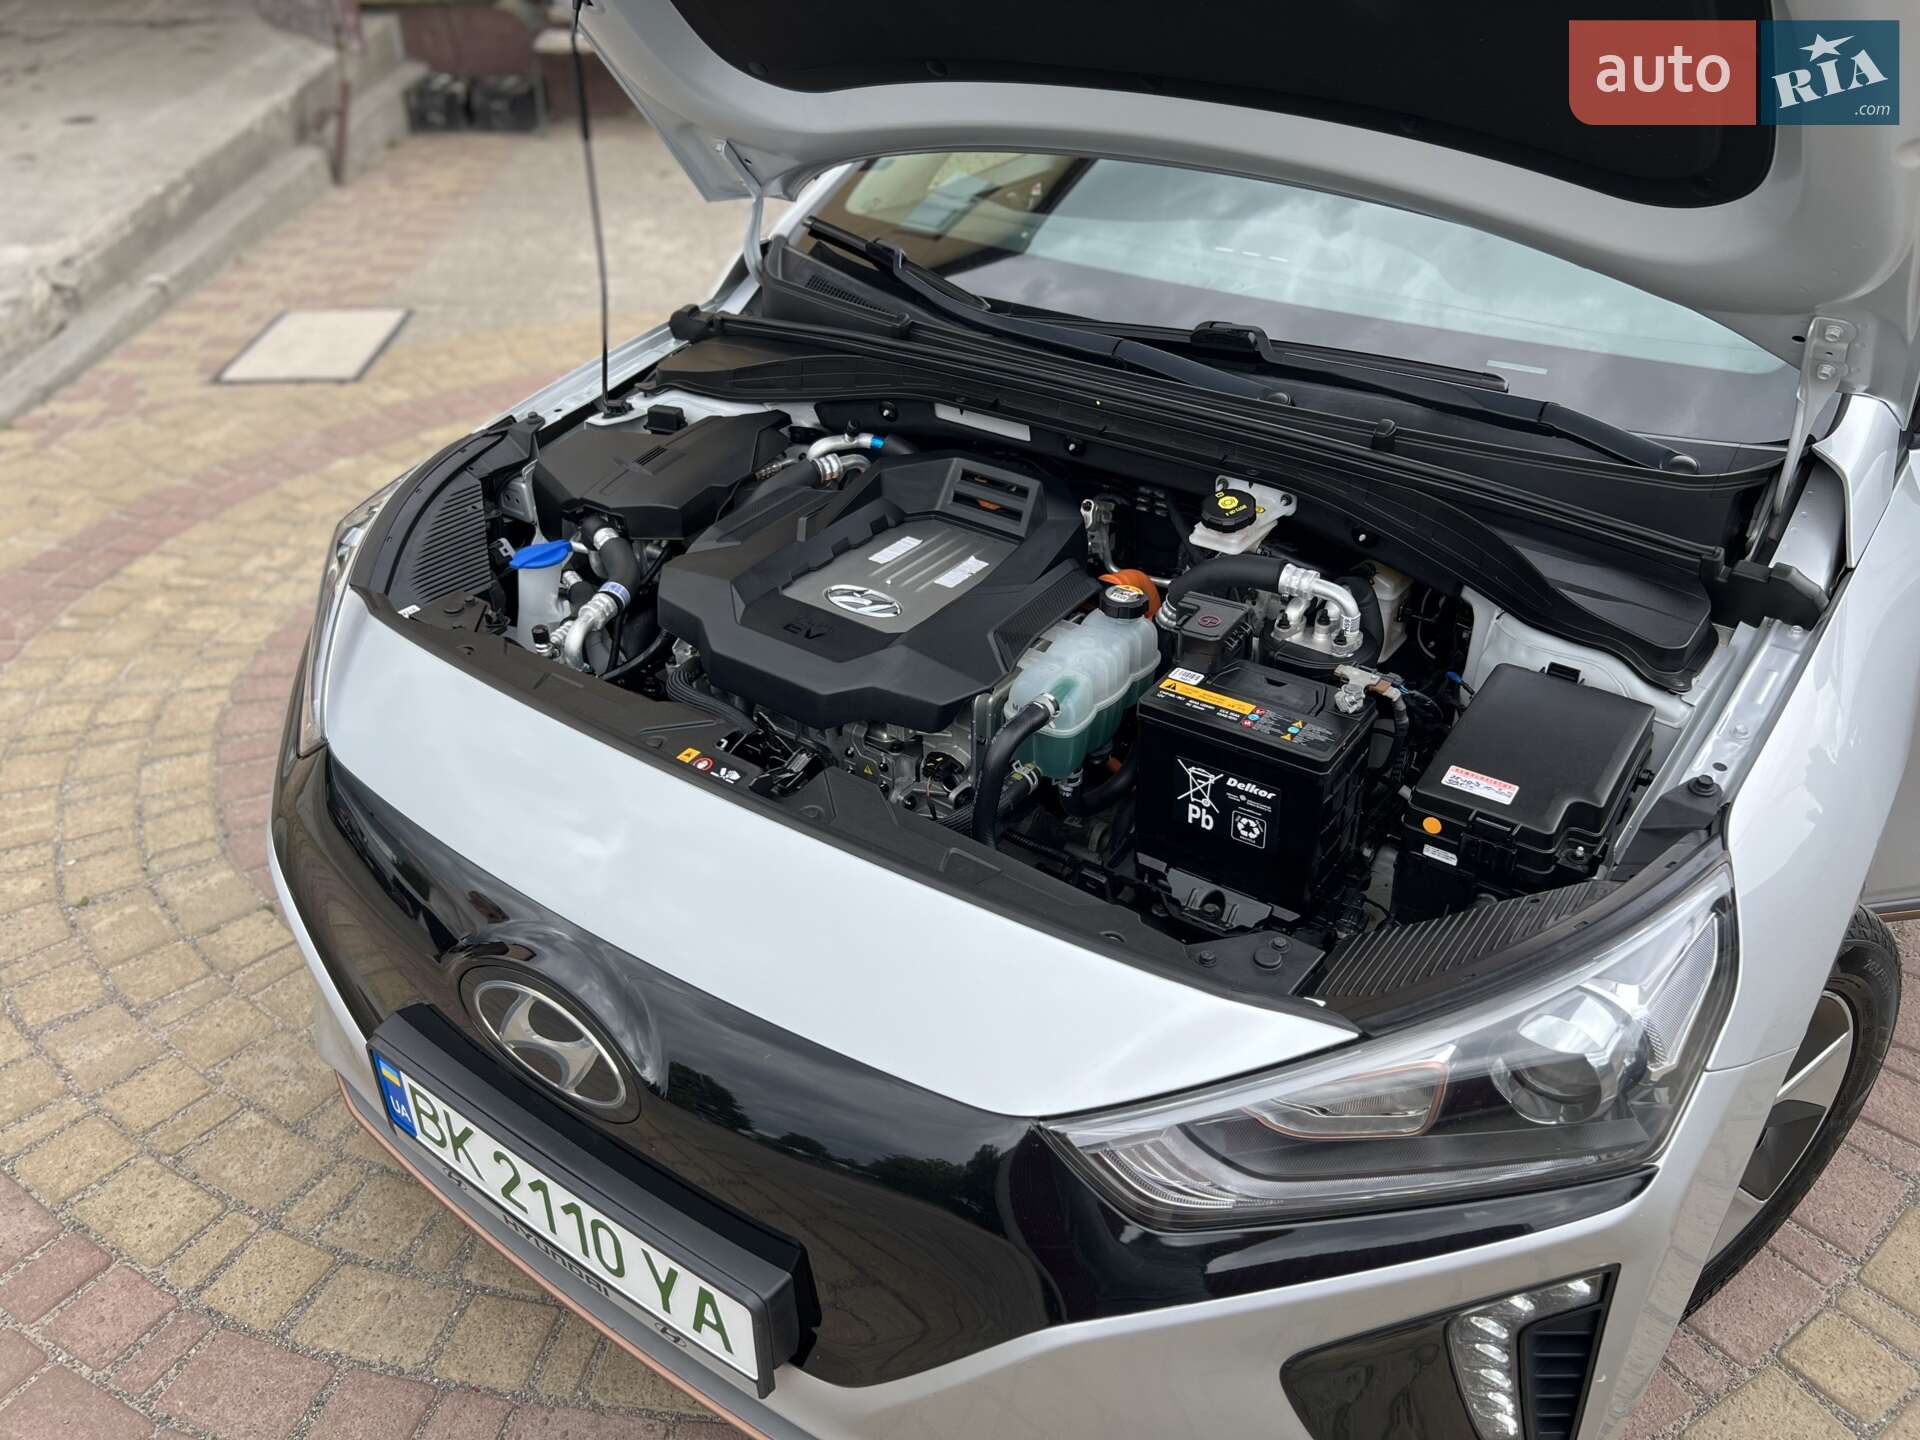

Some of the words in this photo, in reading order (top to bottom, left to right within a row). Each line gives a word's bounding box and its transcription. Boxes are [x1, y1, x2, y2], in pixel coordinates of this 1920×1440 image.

[1226, 777, 1277, 800] Delkor
[1187, 803, 1215, 832] Pb
[390, 1095, 412, 1123] UA
[408, 1081, 487, 1182] BK
[493, 1150, 626, 1279] 2110
[641, 1247, 735, 1356] YA
